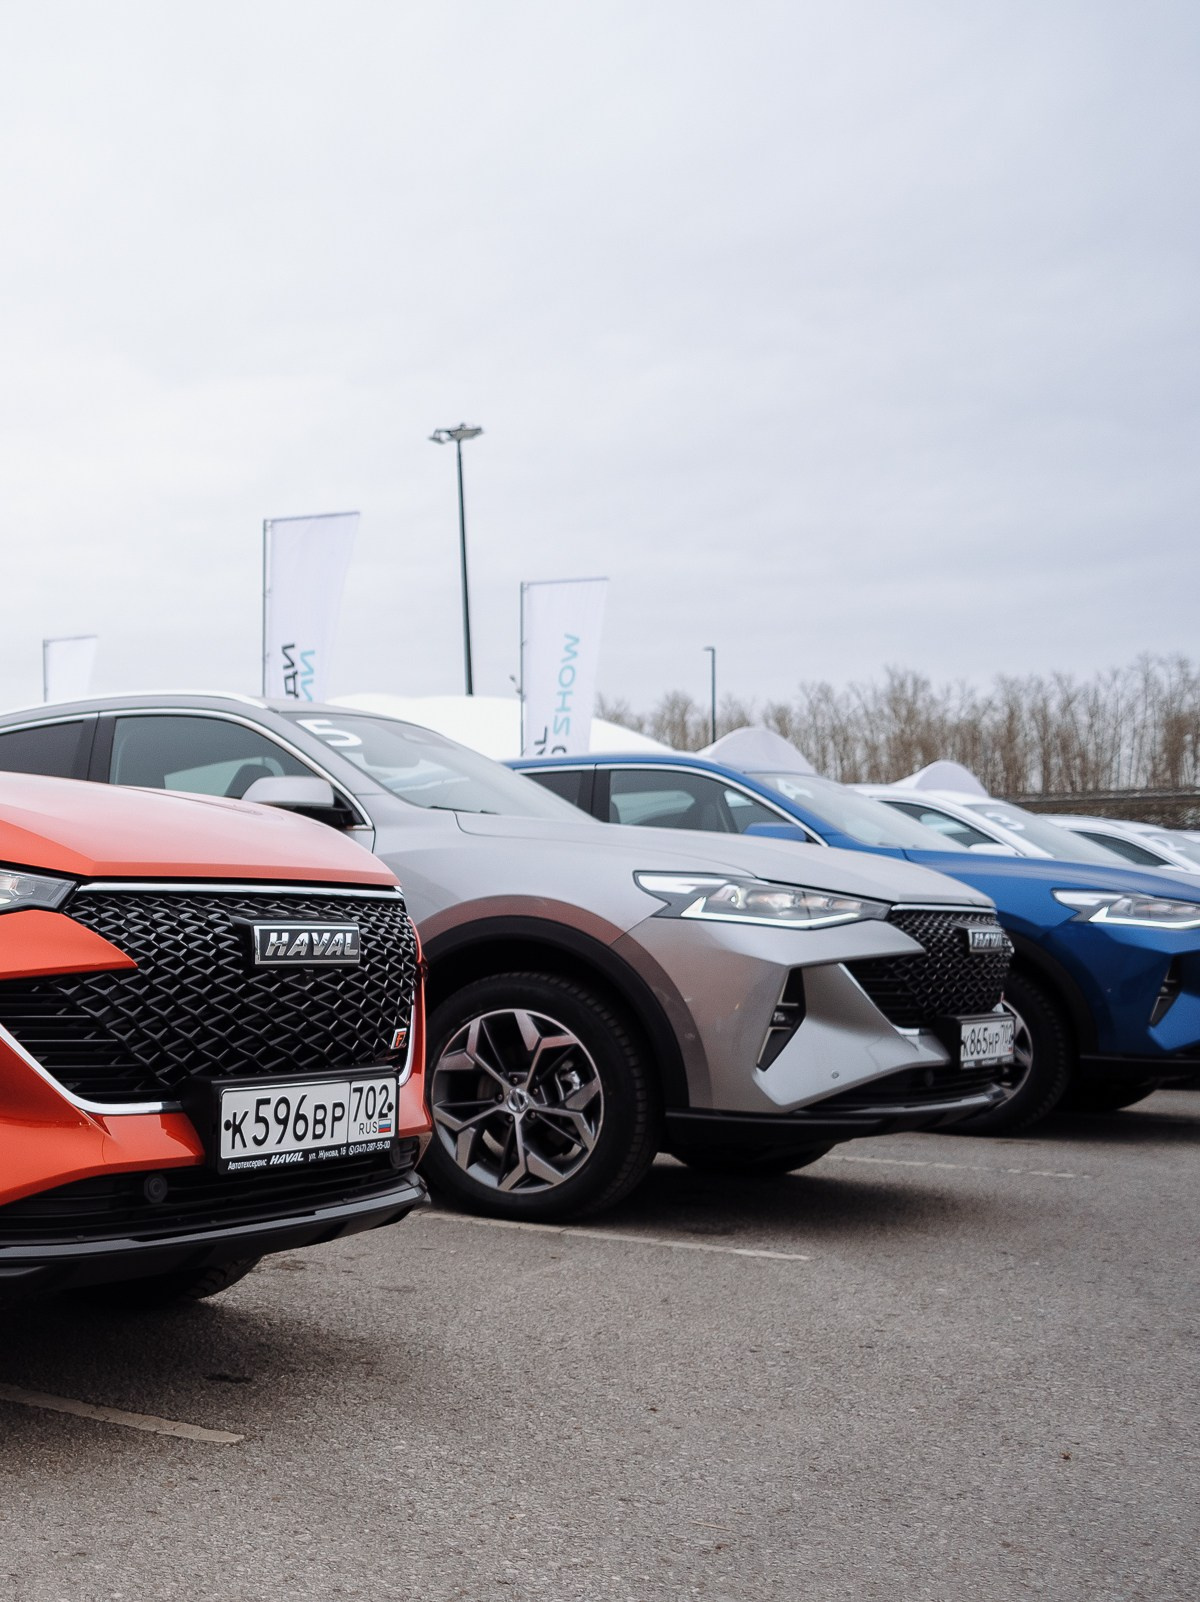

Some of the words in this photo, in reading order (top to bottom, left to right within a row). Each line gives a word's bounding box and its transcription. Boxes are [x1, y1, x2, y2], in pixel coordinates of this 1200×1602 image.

[552, 633, 580, 736] SHOW
[295, 719, 362, 747] 5
[265, 932, 359, 956] HAVAL
[231, 1094, 346, 1150] К596ВР
[352, 1084, 390, 1122] 702
[358, 1121, 378, 1135] RUS
[227, 1159, 267, 1170] Автотехсервис
[269, 1152, 304, 1165] HAVAL
